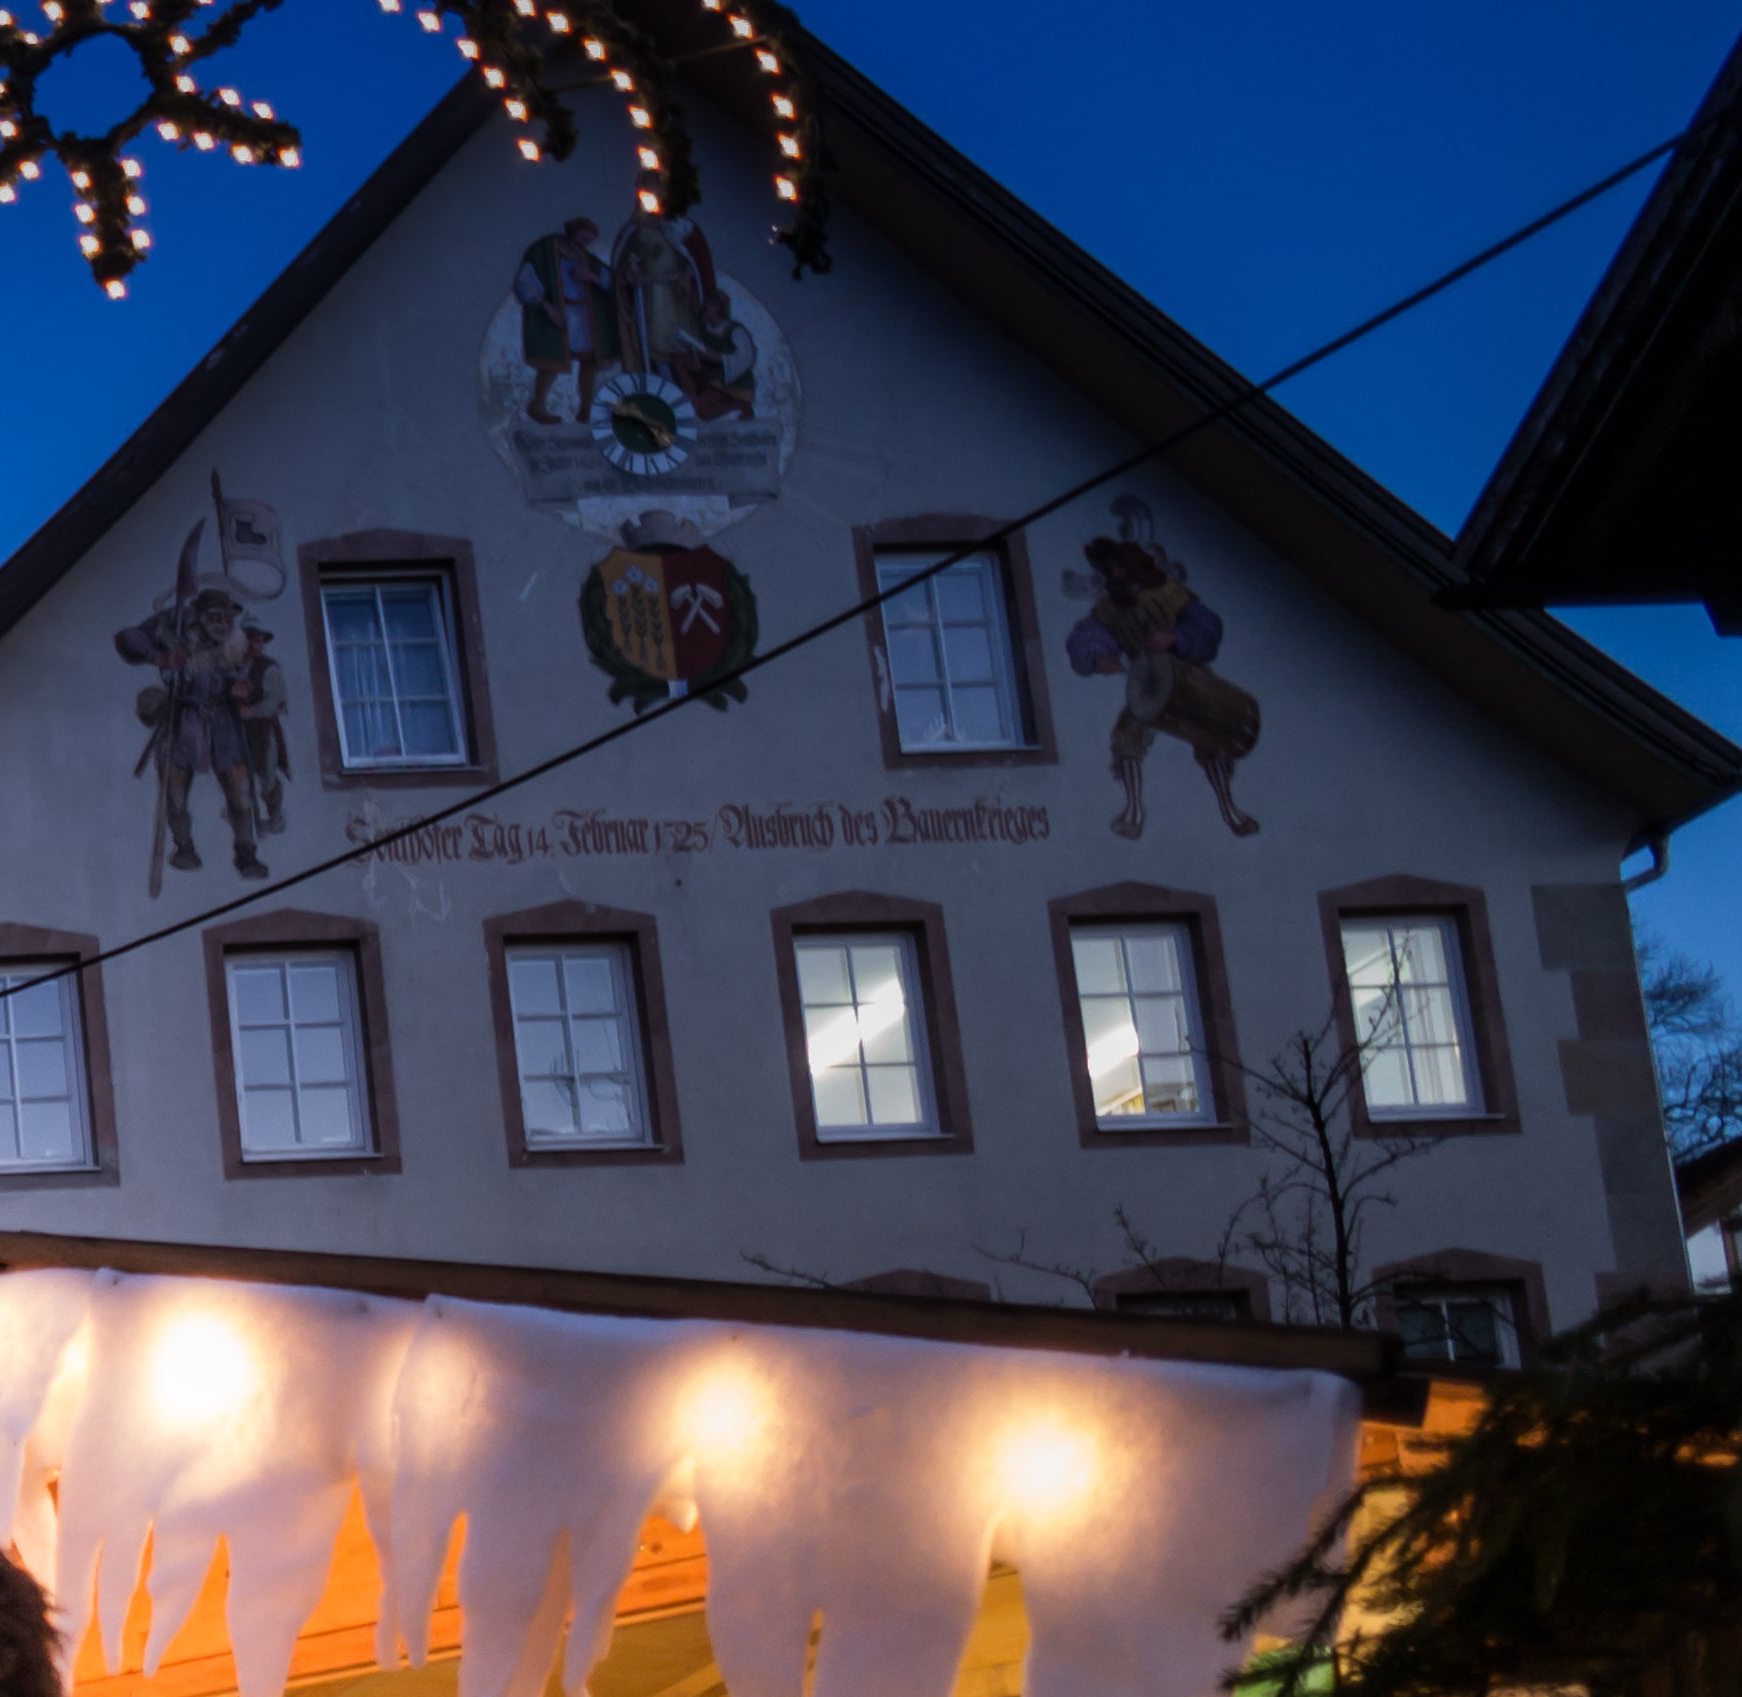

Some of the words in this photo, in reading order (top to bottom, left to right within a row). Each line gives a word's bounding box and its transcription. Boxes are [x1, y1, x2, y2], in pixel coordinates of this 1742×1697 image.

[463, 812, 524, 865] Tag
[552, 807, 649, 859] Februar
[717, 801, 835, 852] Ausbruch
[837, 800, 879, 848] des
[880, 794, 1053, 847] Bauernkrieges
